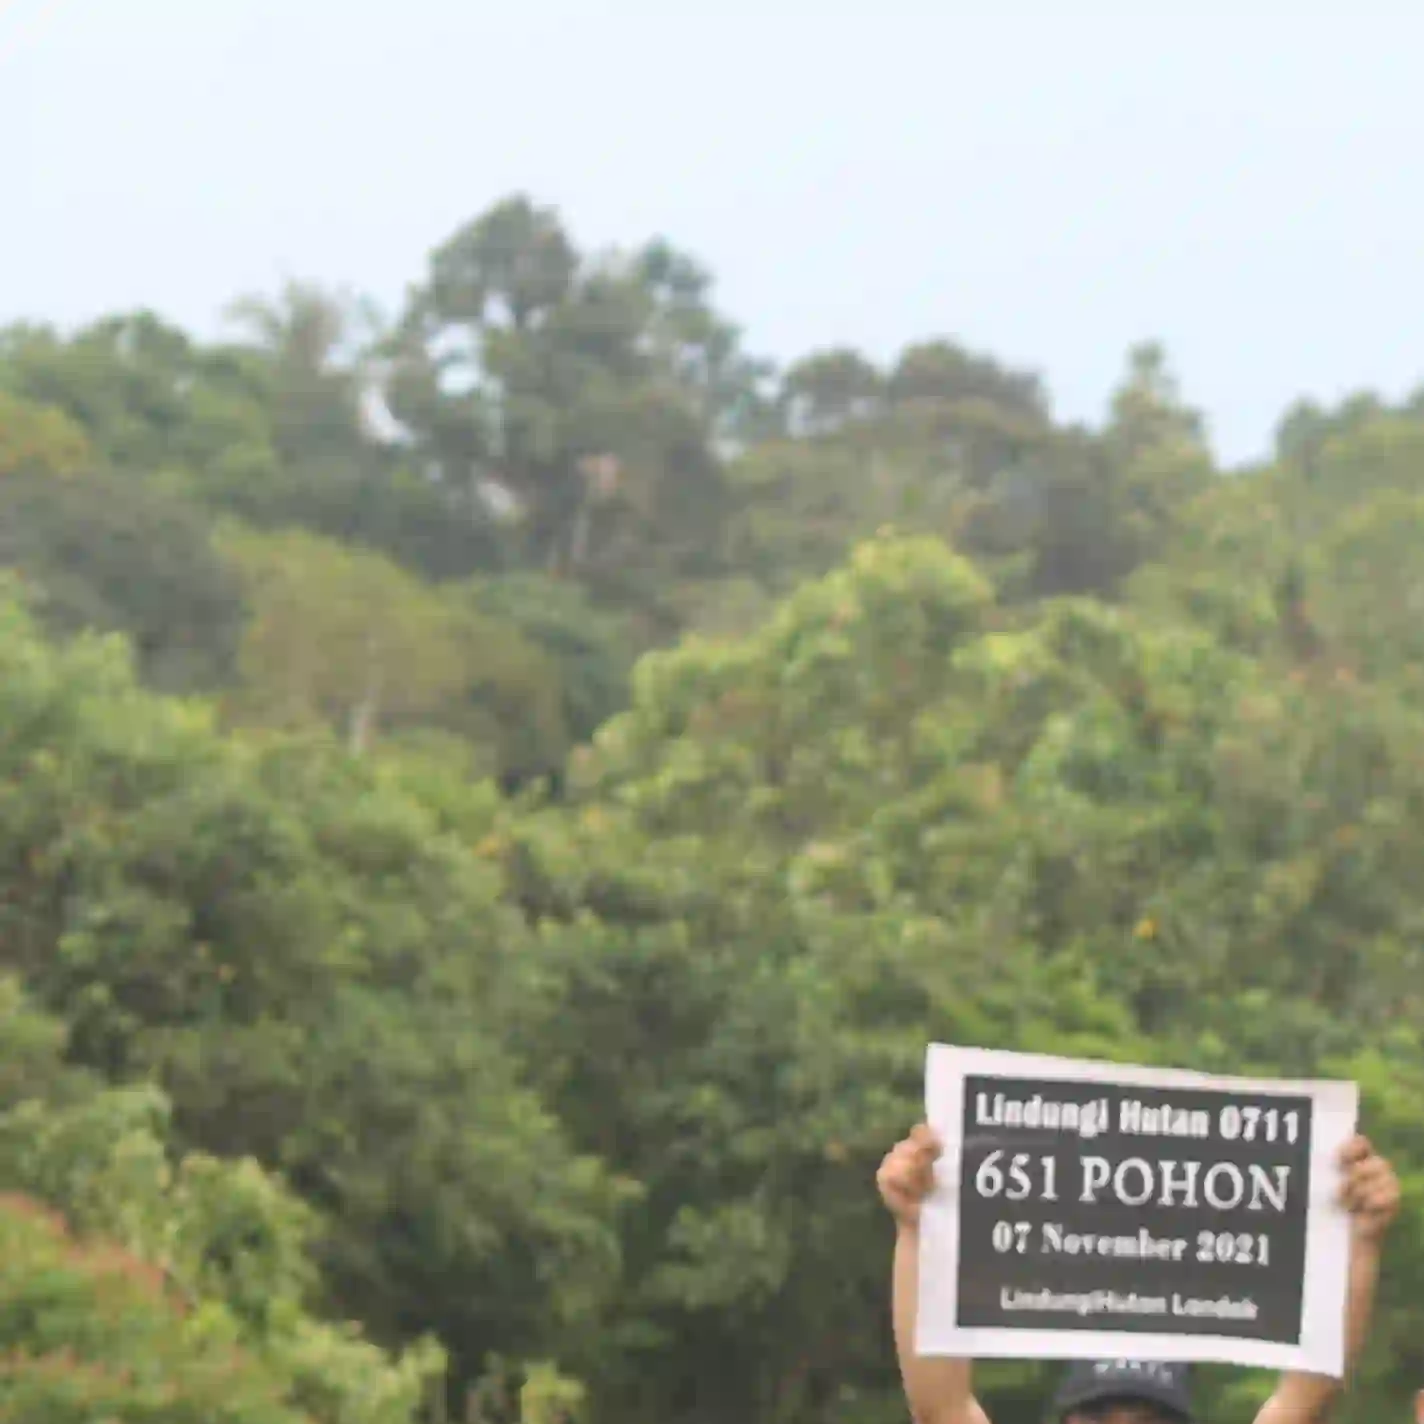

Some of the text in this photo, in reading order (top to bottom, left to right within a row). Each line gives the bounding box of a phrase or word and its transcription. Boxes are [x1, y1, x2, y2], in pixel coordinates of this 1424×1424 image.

[976, 1093, 1299, 1143] Lindungi Hutan 0711
[975, 1150, 1291, 1212] 651 POHON
[992, 1221, 1270, 1266] 07 November 2021
